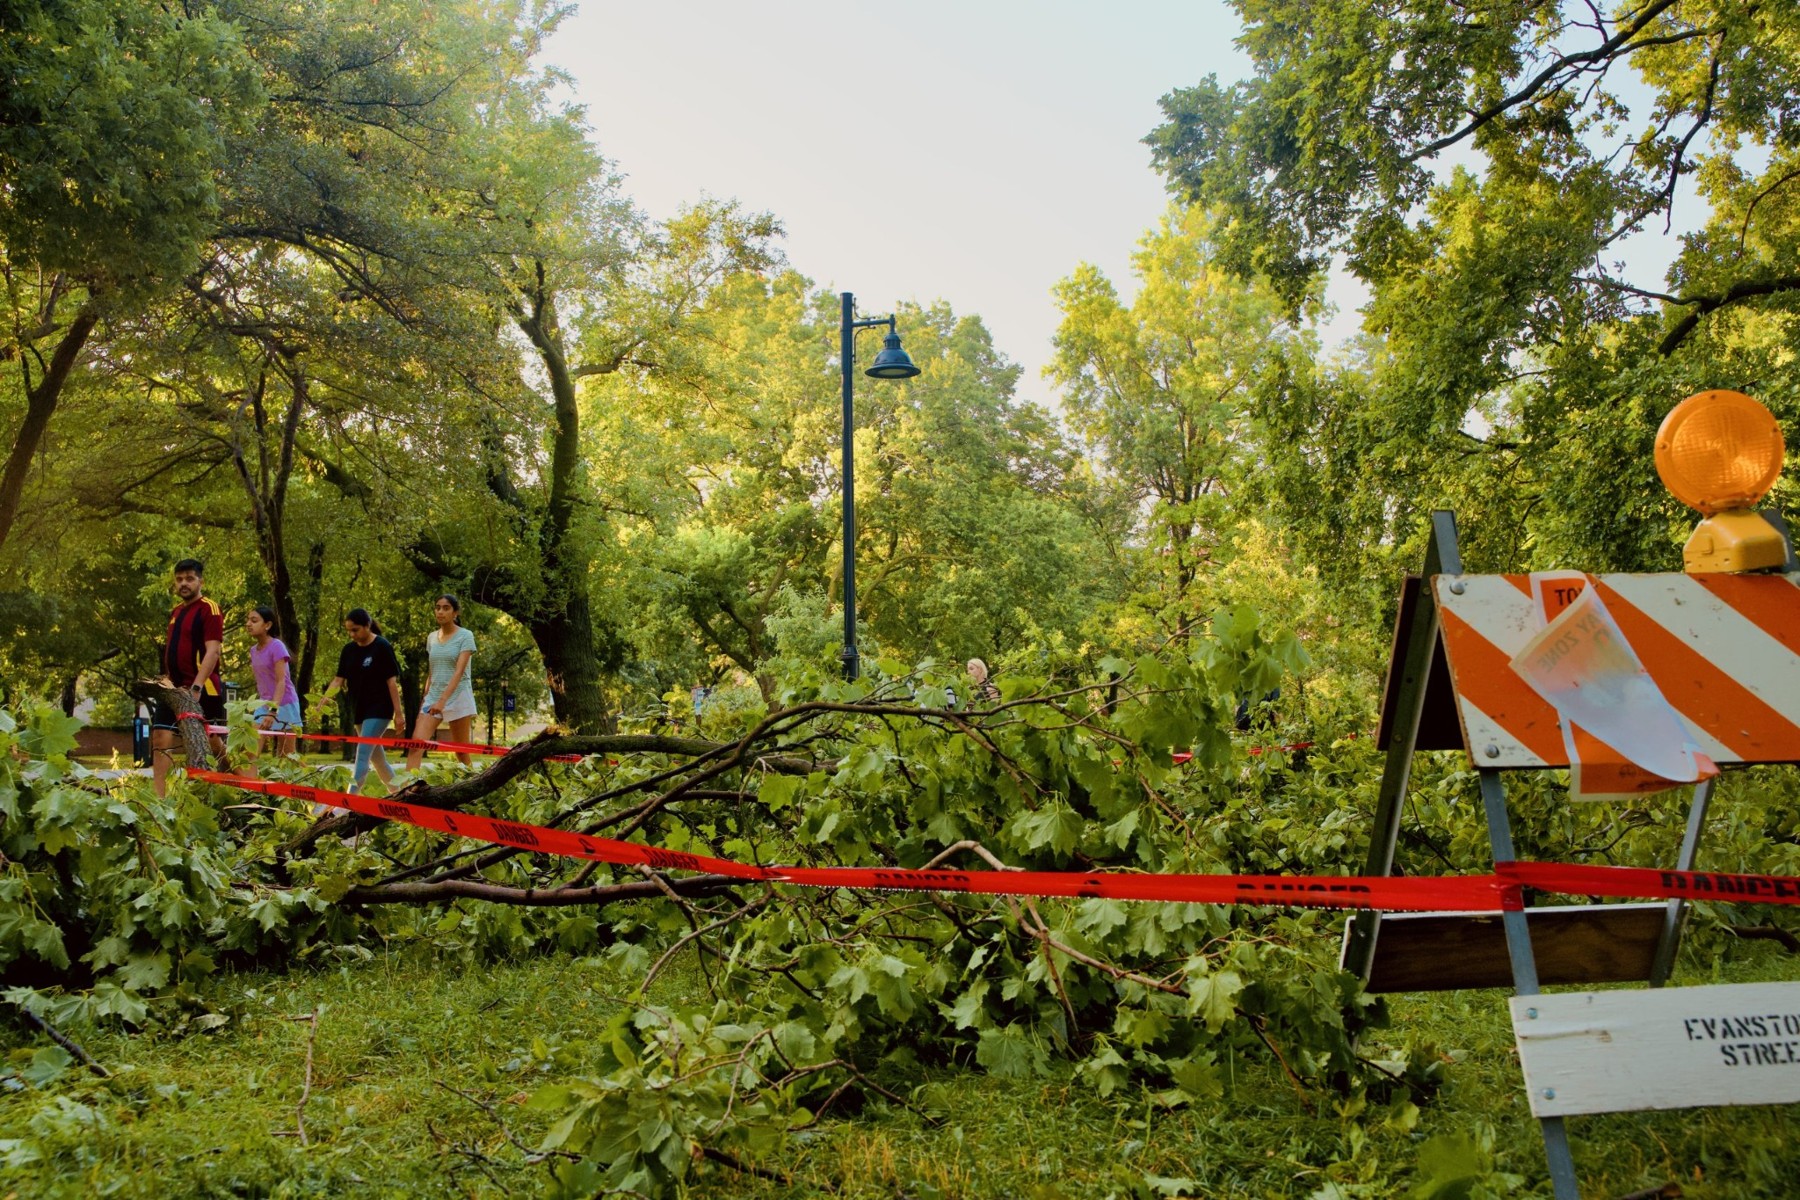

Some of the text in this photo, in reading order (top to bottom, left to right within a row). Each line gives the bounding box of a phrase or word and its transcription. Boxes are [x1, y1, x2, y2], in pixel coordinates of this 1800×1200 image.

[1555, 587, 1584, 607] TO
[378, 803, 416, 823] DANGER
[490, 821, 540, 847] DANGER
[1661, 872, 1800, 898] DANGE
[1684, 1014, 1800, 1040] EVANSTO
